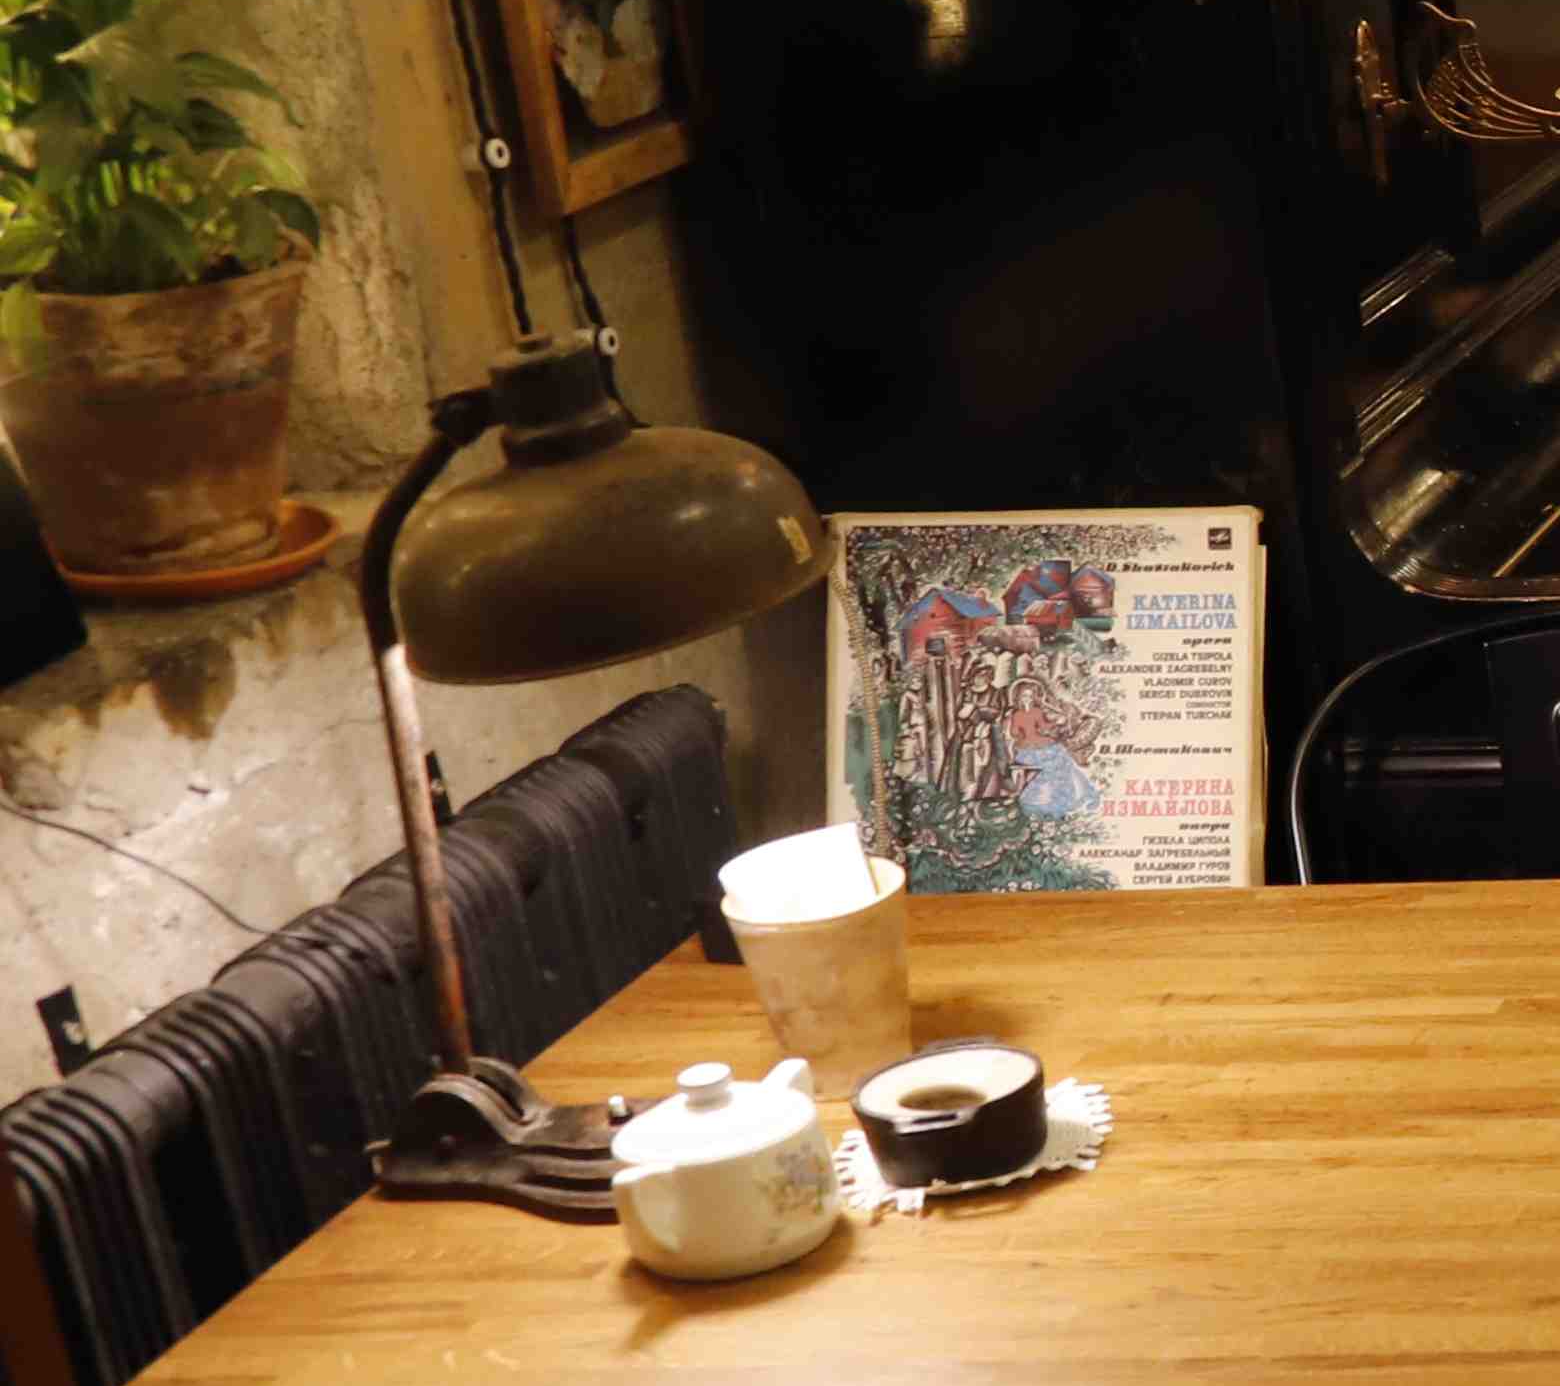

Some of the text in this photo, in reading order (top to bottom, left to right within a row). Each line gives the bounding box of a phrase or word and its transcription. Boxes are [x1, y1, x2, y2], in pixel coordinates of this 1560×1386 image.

[1133, 594, 1237, 611] KATERINA
[1126, 613, 1238, 630] IZMAILOVA
[1182, 637, 1232, 648] opera
[1099, 664, 1232, 674] ALEXANDER ZAGREBELNY
[1143, 677, 1195, 687] VLADIMIR
[1138, 689, 1232, 699] SERGEI DUBROVIN
[1140, 711, 1181, 721] STEPAN
[1125, 778, 1235, 796] КАТЕРИНА
[1102, 796, 1234, 817] ИЗМАЙЛОВА
[1142, 835, 1231, 846] ГИЗЕЛА ЦИПОЛА
[1078, 847, 1231, 859] АЛЕКСАНДР ЗАГРЕБЕЛЬНЫЙ
[1133, 861, 1231, 871] ВЛАДИМИР ГУРОВ
[1132, 873, 1231, 885] СЕРГЕЙ ДУБРОВИН
